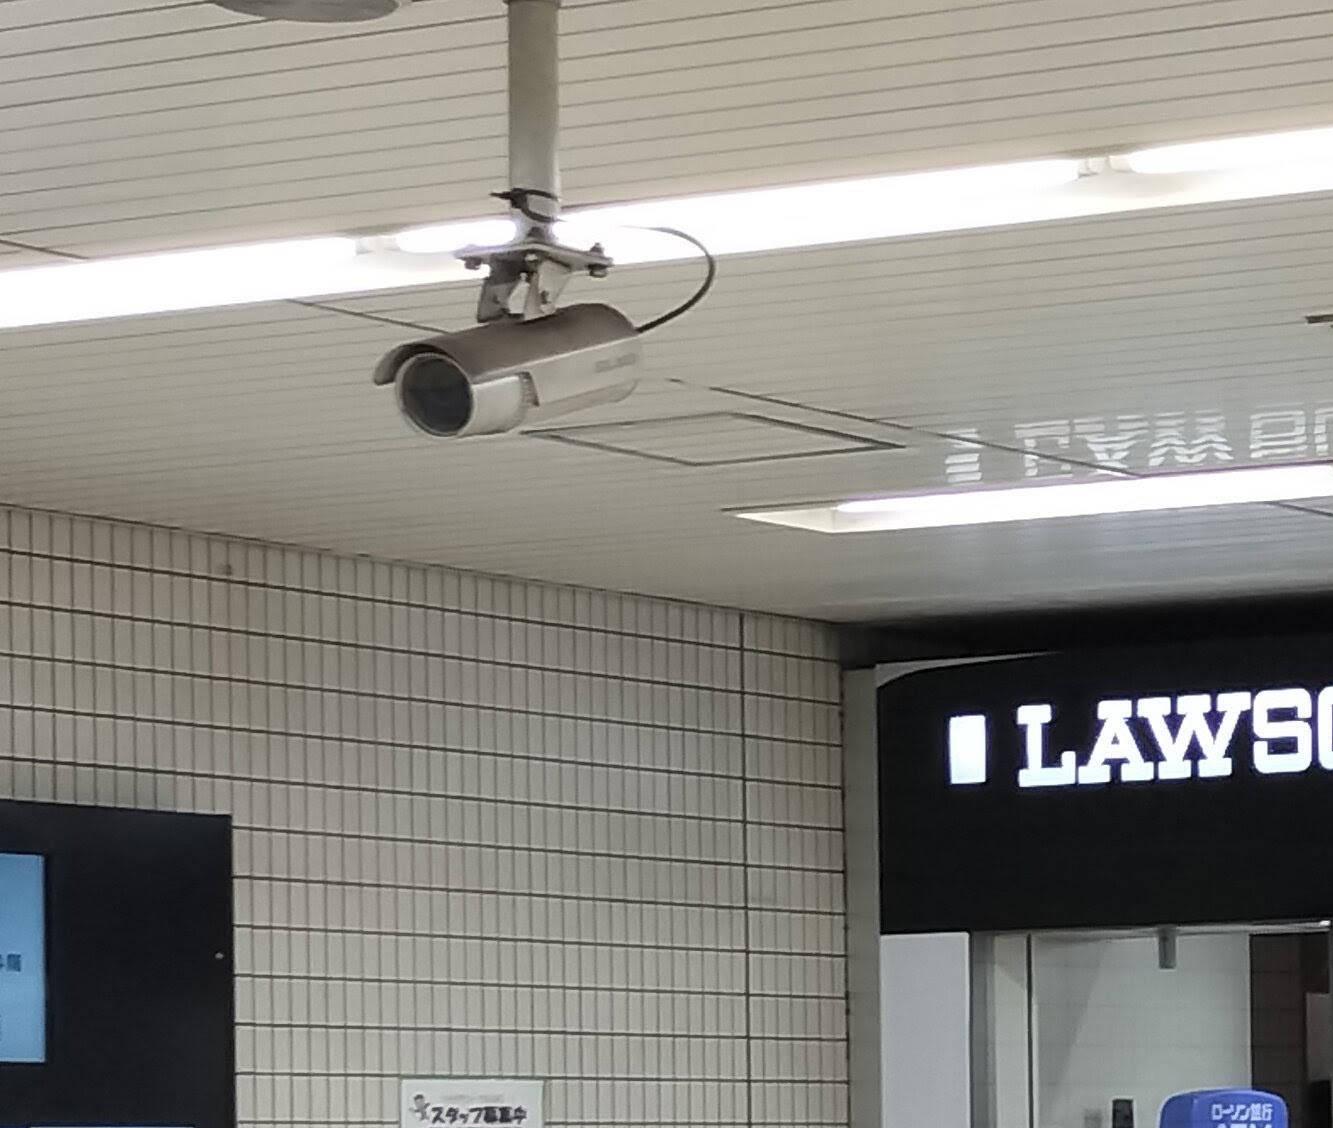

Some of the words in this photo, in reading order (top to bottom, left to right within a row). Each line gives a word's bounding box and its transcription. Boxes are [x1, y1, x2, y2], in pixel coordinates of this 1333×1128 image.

[1212, 1103, 1272, 1120] ローソン銀行
